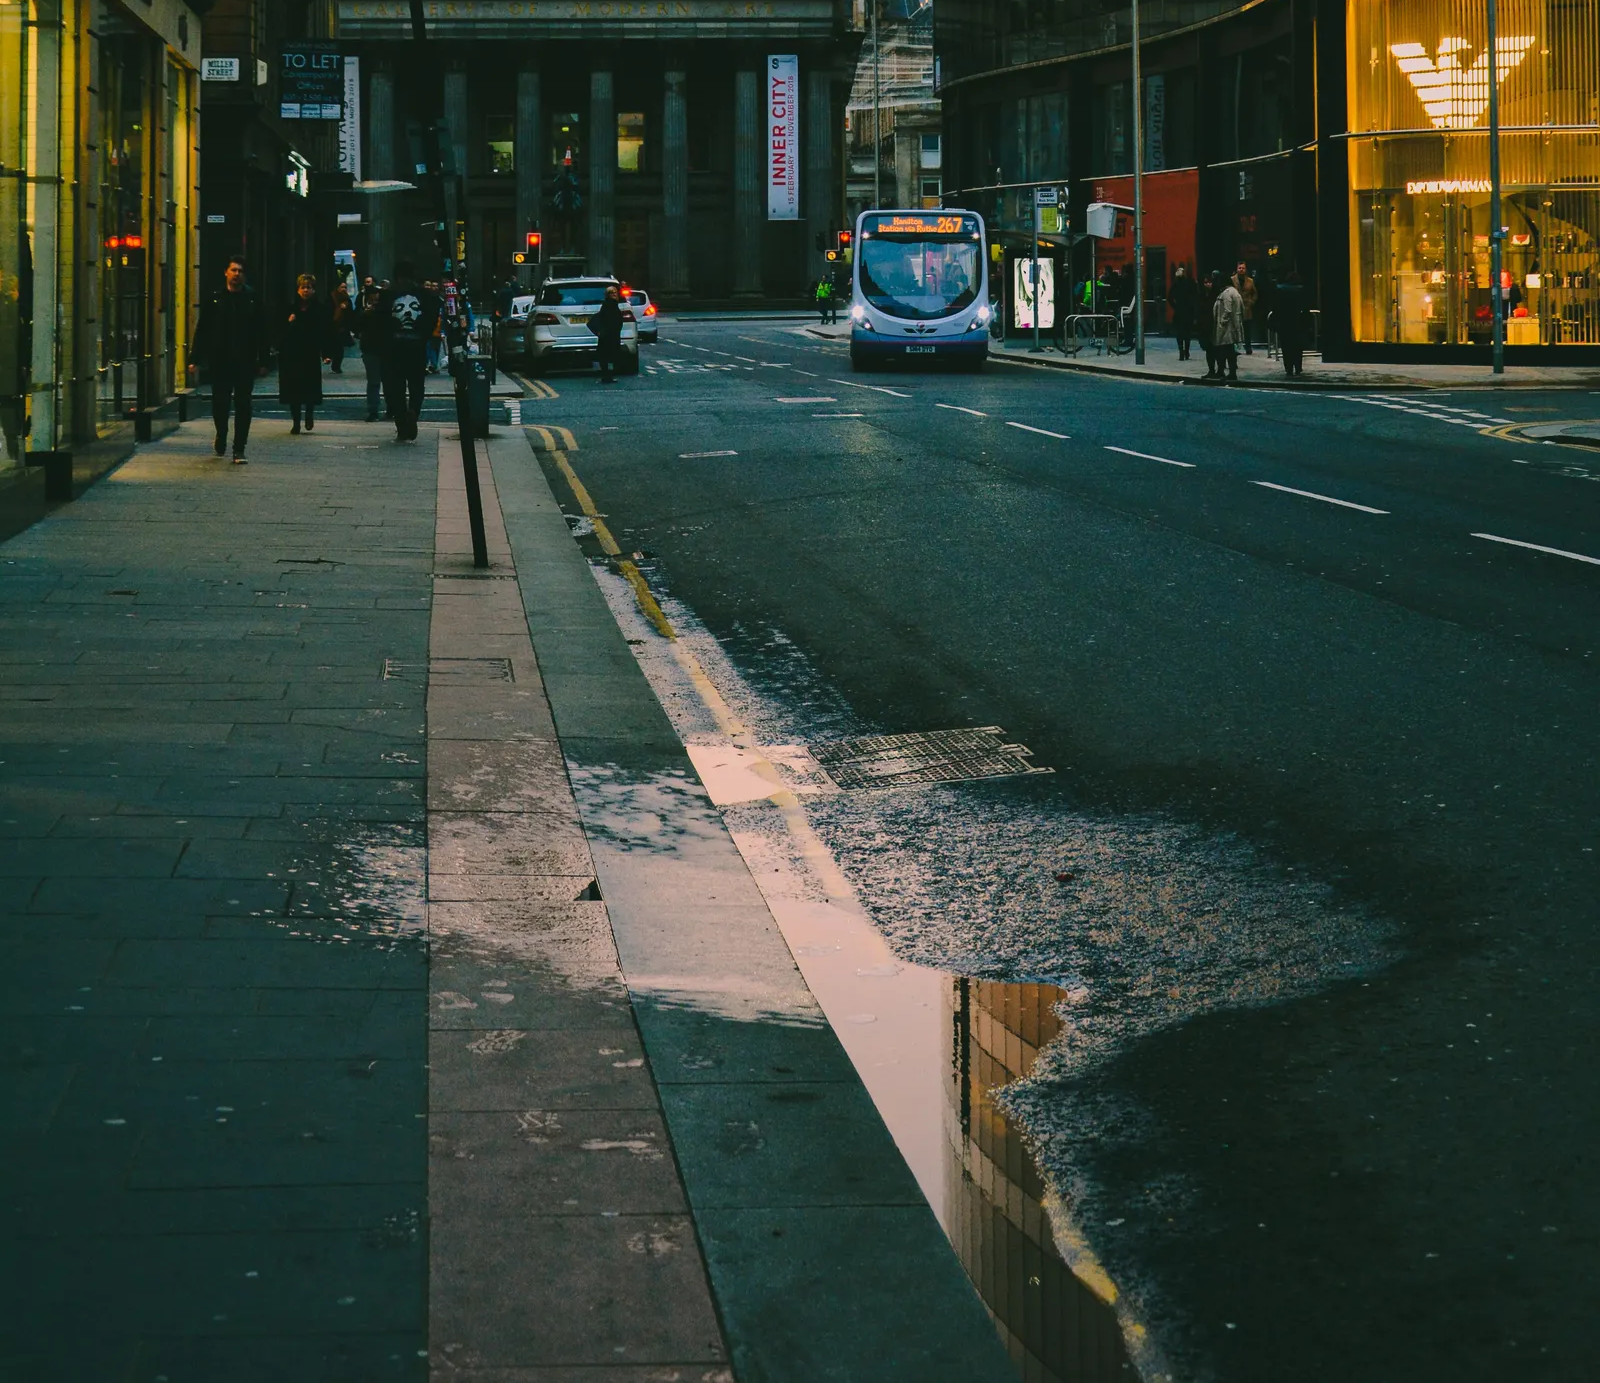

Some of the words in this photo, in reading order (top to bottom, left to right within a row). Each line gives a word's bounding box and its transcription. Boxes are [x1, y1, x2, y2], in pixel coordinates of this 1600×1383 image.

[353, 1, 473, 17] GALERY
[508, 1, 538, 16] OF
[574, 1, 690, 16] MODERN
[726, 1, 775, 16] ART
[208, 60, 234, 68] MILLER
[282, 54, 306, 69] TO
[312, 54, 341, 70] LET
[772, 77, 786, 119] CITY
[772, 125, 786, 186] INNER
[1453, 180, 1493, 194] ARMAN
[937, 216, 963, 233] 267
